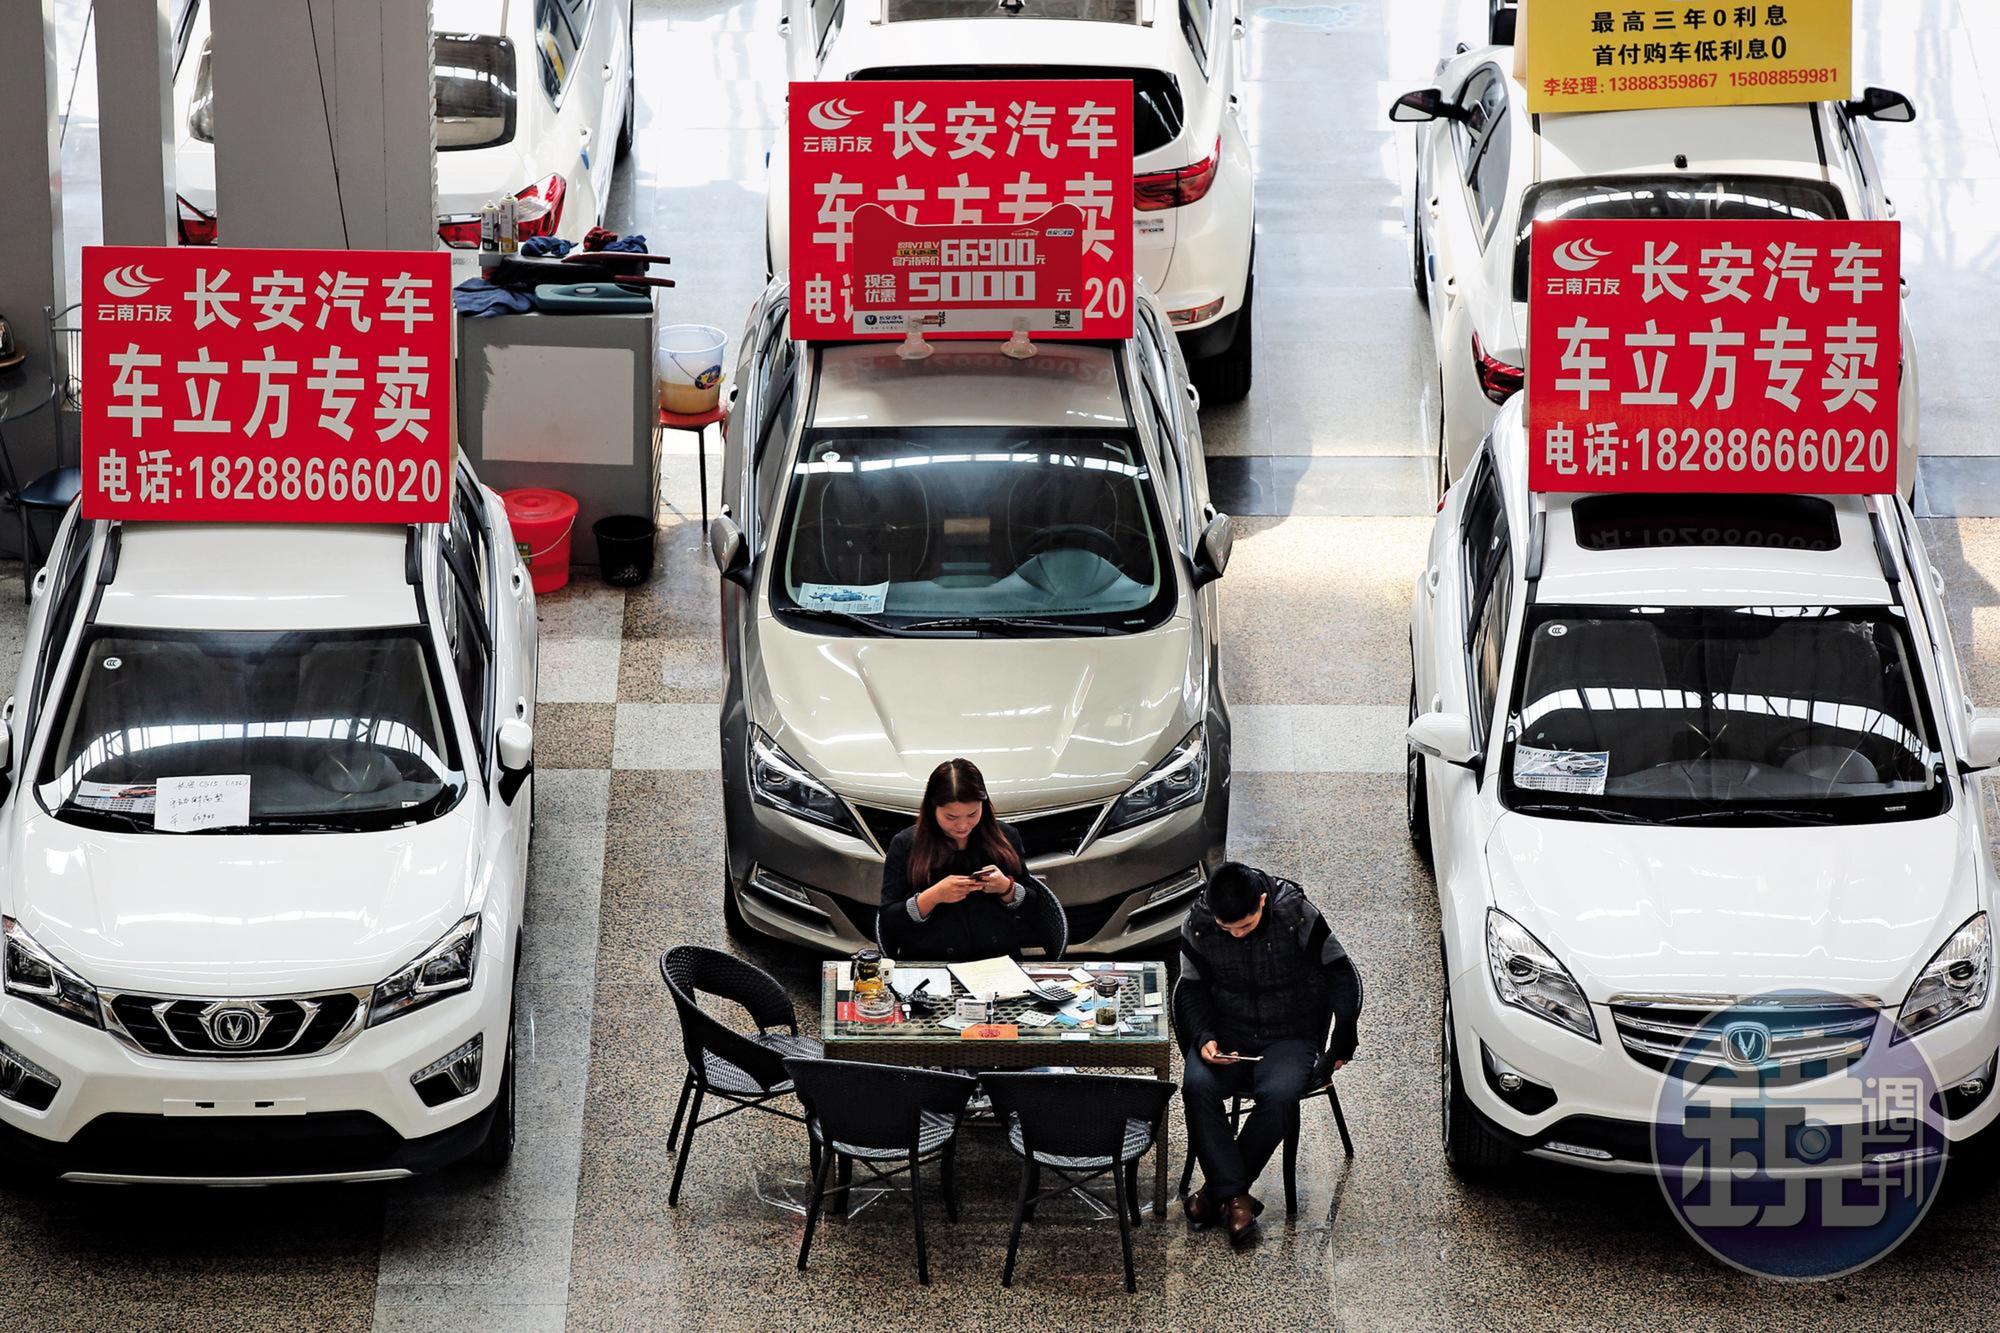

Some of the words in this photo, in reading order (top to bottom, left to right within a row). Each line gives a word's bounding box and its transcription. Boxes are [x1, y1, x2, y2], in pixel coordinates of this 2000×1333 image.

[1591, 4, 1788, 34] 最高三年0利息
[1592, 35, 1787, 67] 首付购车低利息0
[1729, 68, 1838, 87] 15808859981
[803, 135, 873, 153] 云南万友
[882, 100, 1118, 160] 长安汽车
[940, 238, 1035, 267] 66900
[1035, 254, 1046, 265] 元
[864, 273, 897, 289] 现金
[908, 270, 1036, 302] 5000
[1056, 288, 1072, 302] 元
[1546, 277, 1621, 296] 云南万友
[1631, 240, 1884, 304] 长安汽车
[183, 268, 434, 334] 长安汽车
[864, 288, 897, 303] 优惠
[97, 303, 173, 323] 云南万友
[1554, 315, 1879, 414] 车立方专卖
[107, 342, 431, 444] 车立方专卖
[1545, 421, 1889, 477] 电话:18288666020
[98, 448, 442, 504] 电话:18288666020
